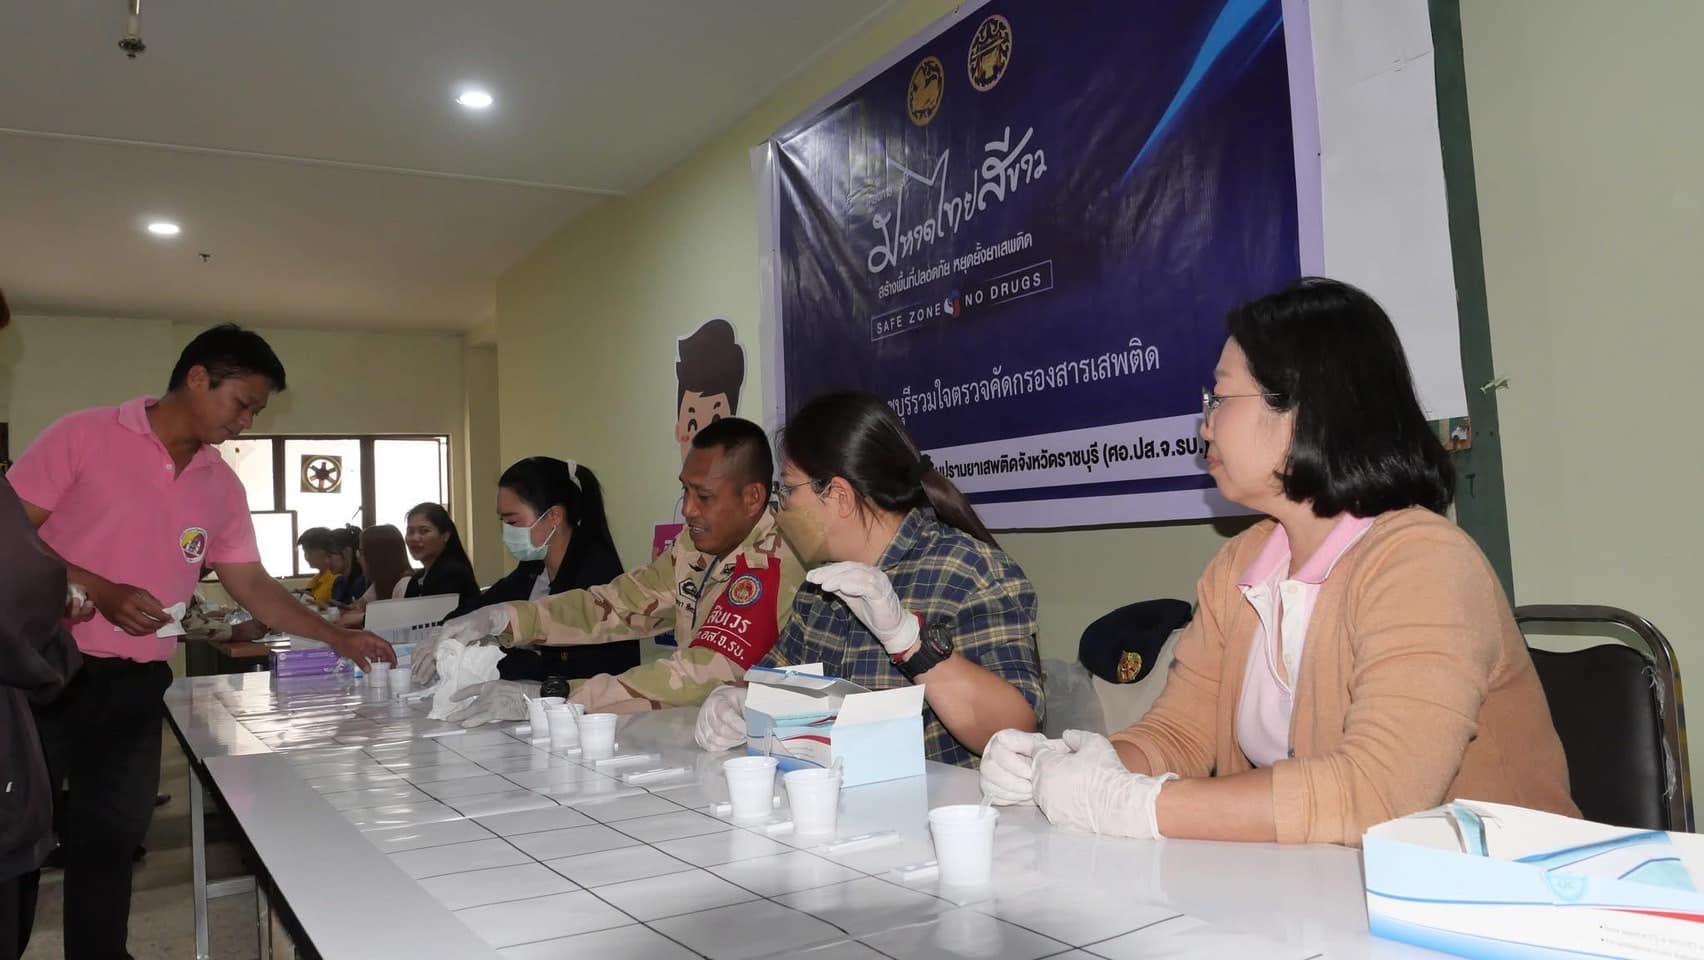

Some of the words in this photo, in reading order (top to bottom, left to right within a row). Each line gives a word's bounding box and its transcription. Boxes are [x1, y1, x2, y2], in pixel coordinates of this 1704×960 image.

[868, 126, 1048, 274] มหาดไทยสีขาว
[878, 259, 951, 299] สร้างพื้นที่ปลอดภัย
[953, 231, 1033, 275] หยุดยั้งยาเสพติด
[876, 315, 902, 335] SAFE
[909, 303, 942, 325] ZONE
[965, 290, 984, 307] NO
[990, 272, 1042, 300] DRUGS
[935, 441, 1100, 478] ปรามยาเสพติดจังหวัดราชบุรี
